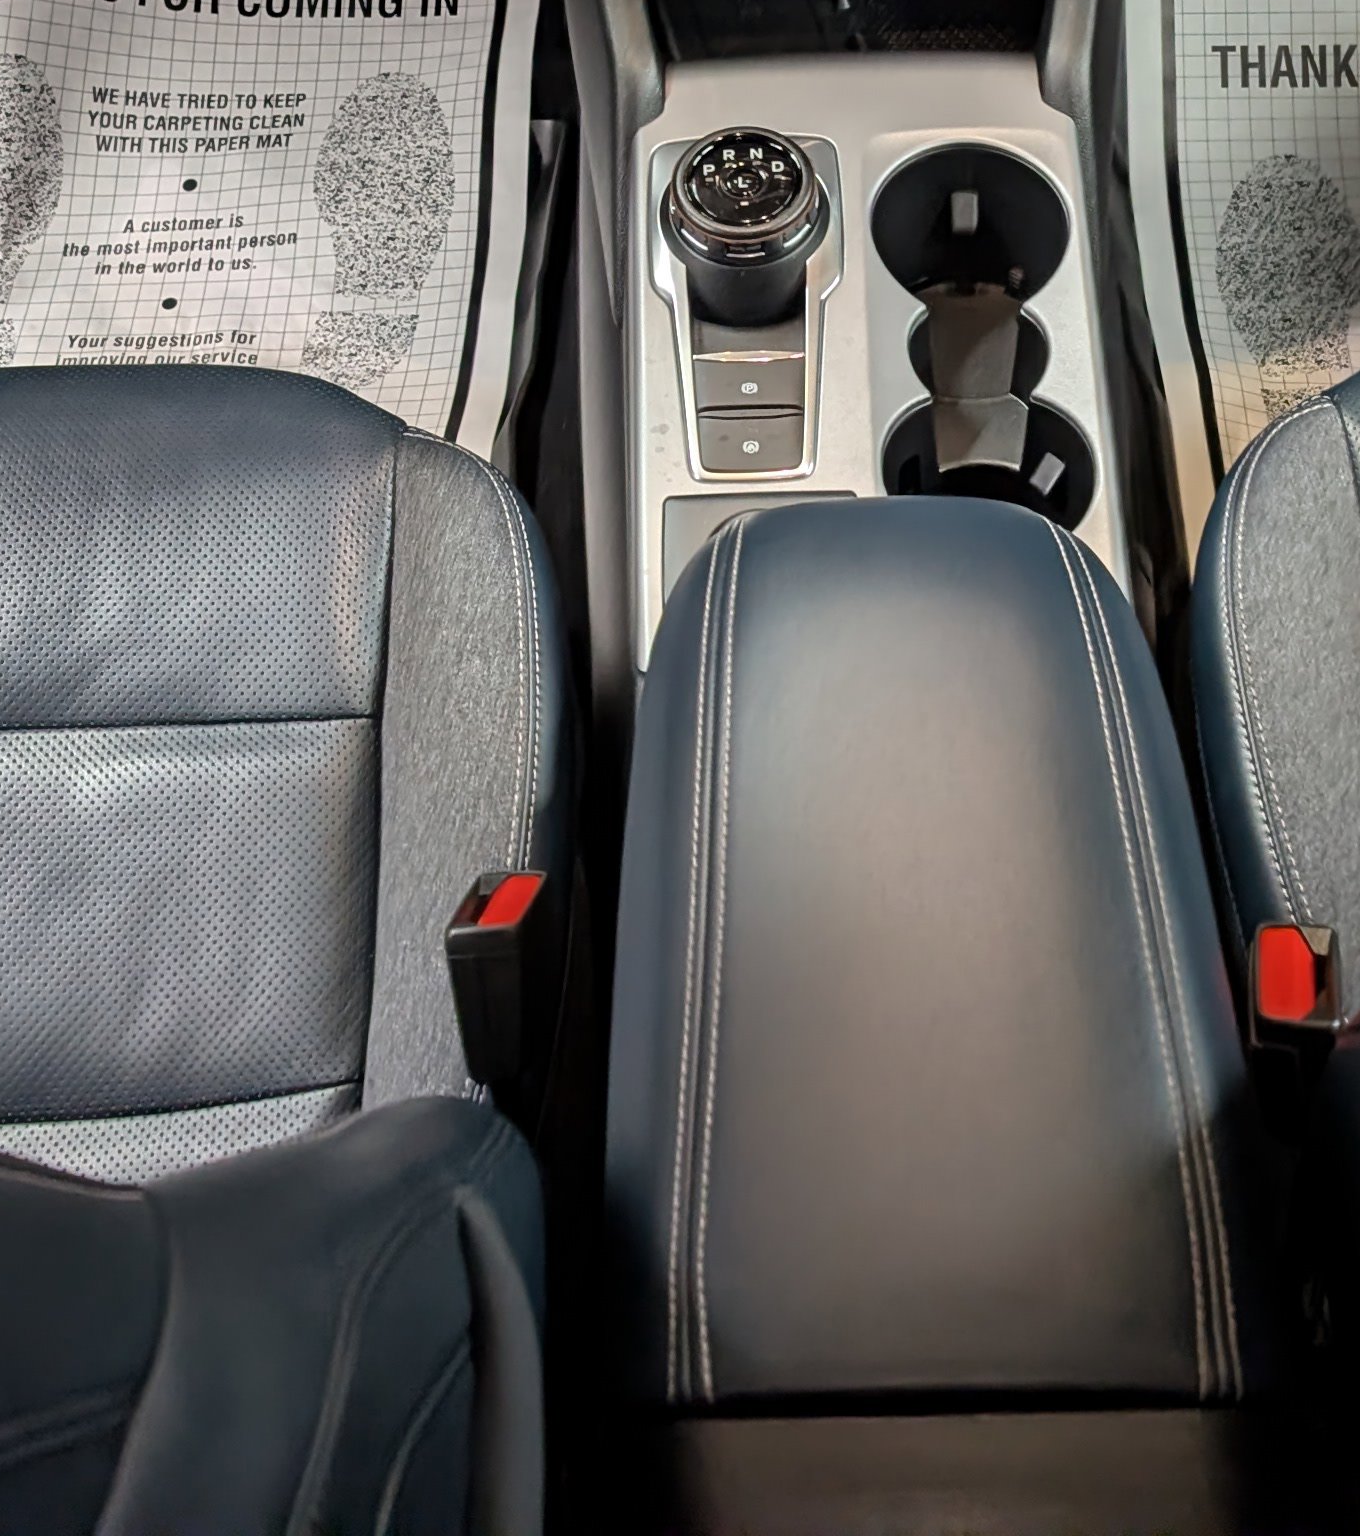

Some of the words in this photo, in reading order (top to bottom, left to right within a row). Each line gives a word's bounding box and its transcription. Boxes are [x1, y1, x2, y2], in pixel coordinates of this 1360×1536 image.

[92, 86, 119, 105] WE
[125, 90, 171, 108] HAVE
[177, 93, 228, 109] TRIED
[235, 94, 256, 109] TO
[263, 93, 307, 109] KEEP
[88, 110, 137, 129] YOUR
[144, 115, 243, 131] CARPETING
[249, 113, 305, 130] CLEAN
[96, 135, 141, 153] WITH
[149, 137, 189, 154] THIS
[194, 136, 250, 153] PAPER
[256, 133, 293, 149] MAT
[722, 149, 736, 161] R
[749, 148, 763, 160] N
[703, 164, 716, 177] P
[771, 161, 785, 173] D
[737, 176, 749, 189] L
[123, 219, 134, 233] A
[141, 216, 223, 233] customer
[228, 214, 244, 228] is
[63, 243, 90, 257] the
[97, 240, 140, 255] most
[146, 235, 232, 256] important
[238, 232, 297, 252] person
[95, 262, 111, 275] in
[118, 261, 145, 274] the
[153, 258, 201, 273] world
[208, 258, 224, 271] to
[231, 258, 258, 270] us.
[68, 335, 108, 349] Your
[113, 330, 223, 350] suggestions
[230, 330, 258, 345] for
[154, 354, 186, 365] our
[191, 350, 258, 365] service
